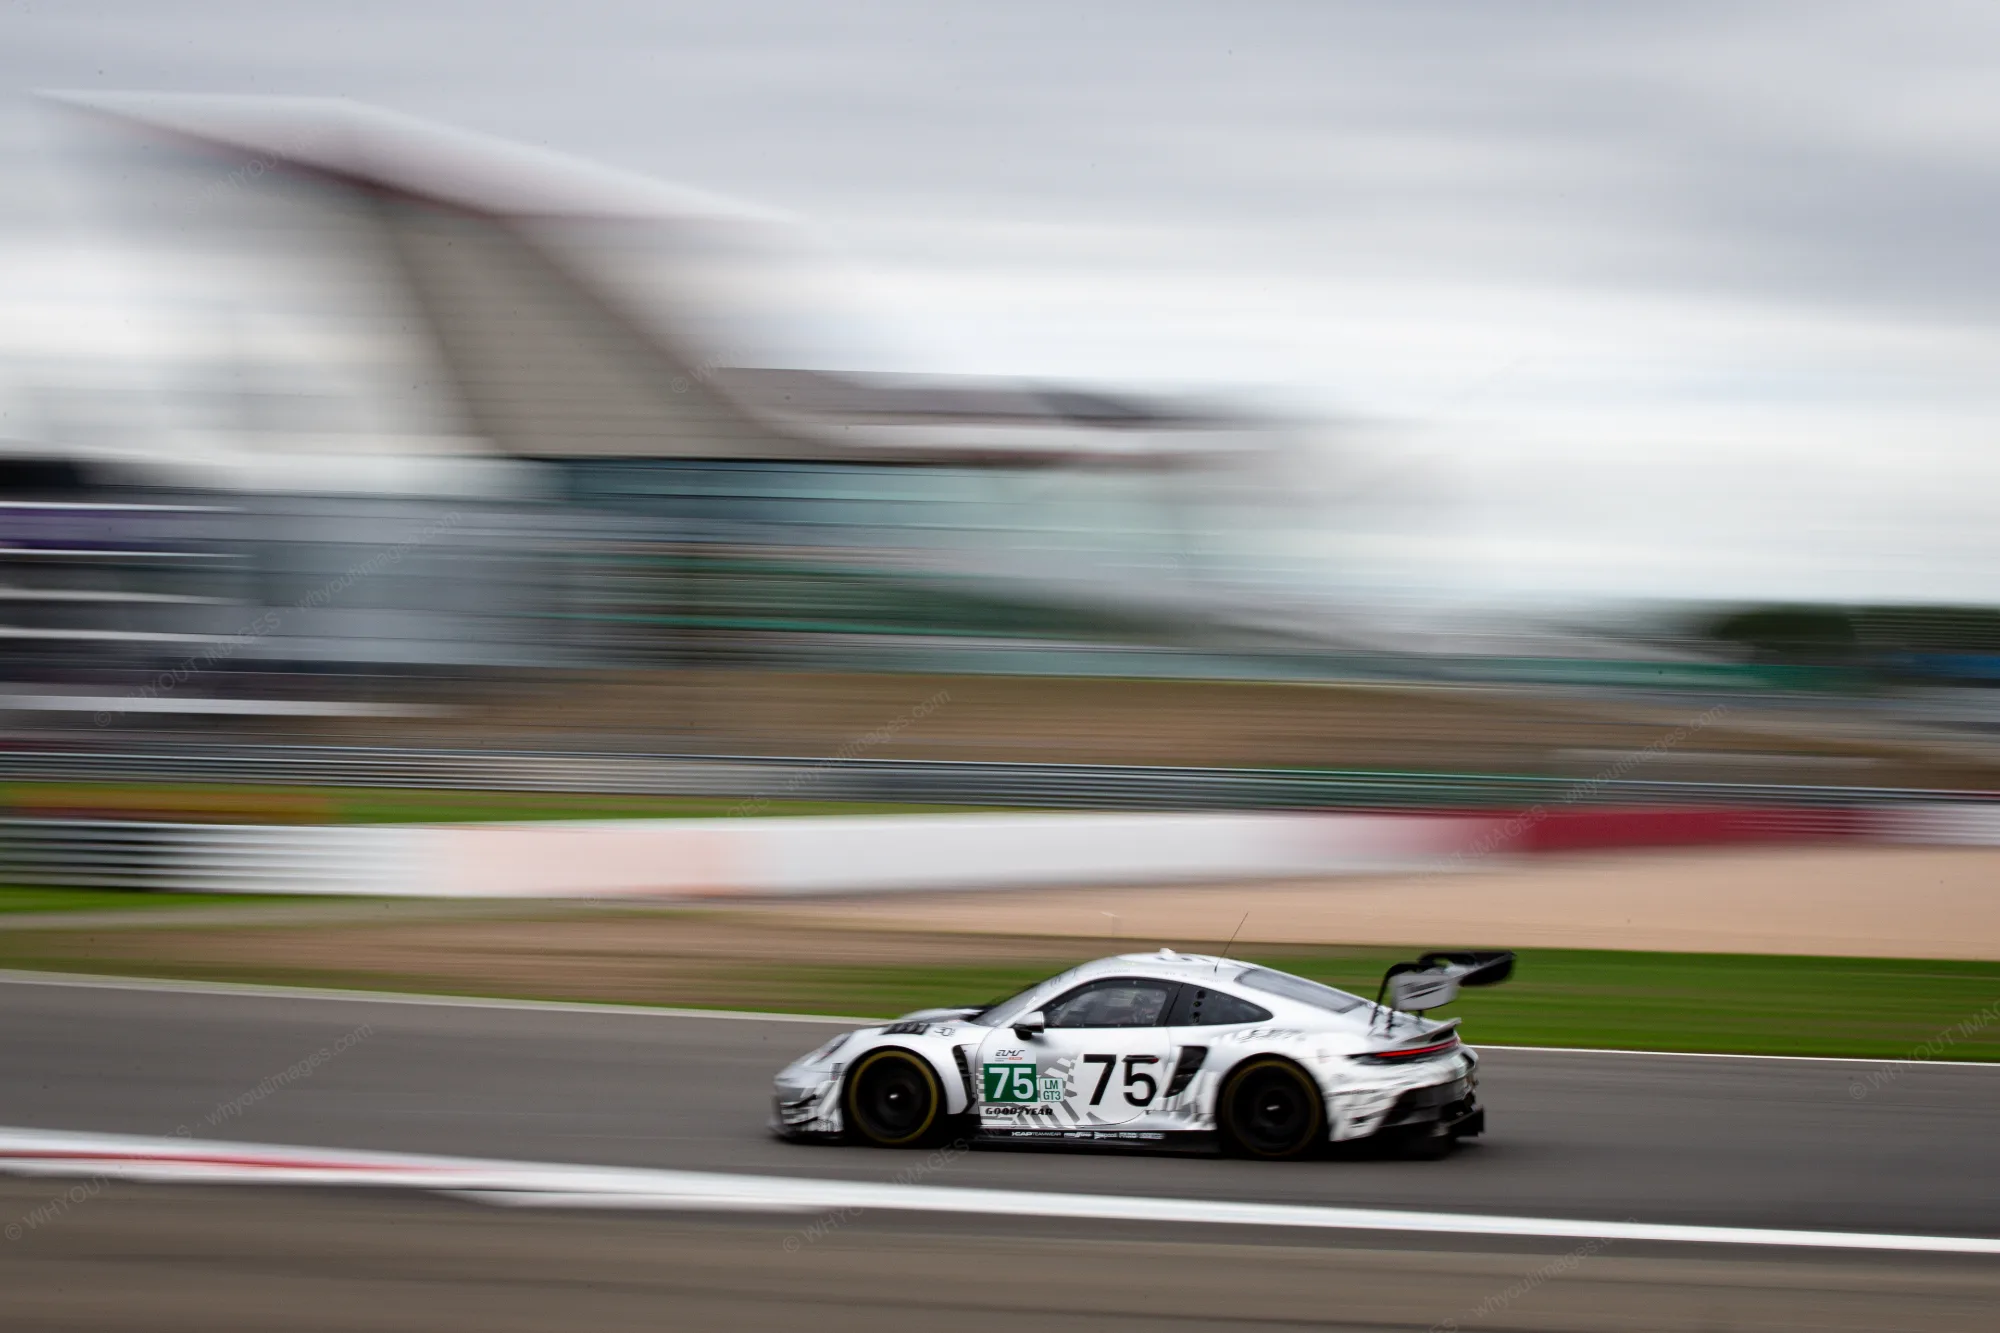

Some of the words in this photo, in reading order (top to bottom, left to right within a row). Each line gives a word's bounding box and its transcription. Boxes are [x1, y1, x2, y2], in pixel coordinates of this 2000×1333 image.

[988, 1066, 1035, 1100] 75
[1044, 1079, 1059, 1090] LM
[1082, 1053, 1160, 1108] 75
[1042, 1090, 1061, 1101] GT3
[985, 1104, 1054, 1116] GOODYEAR
